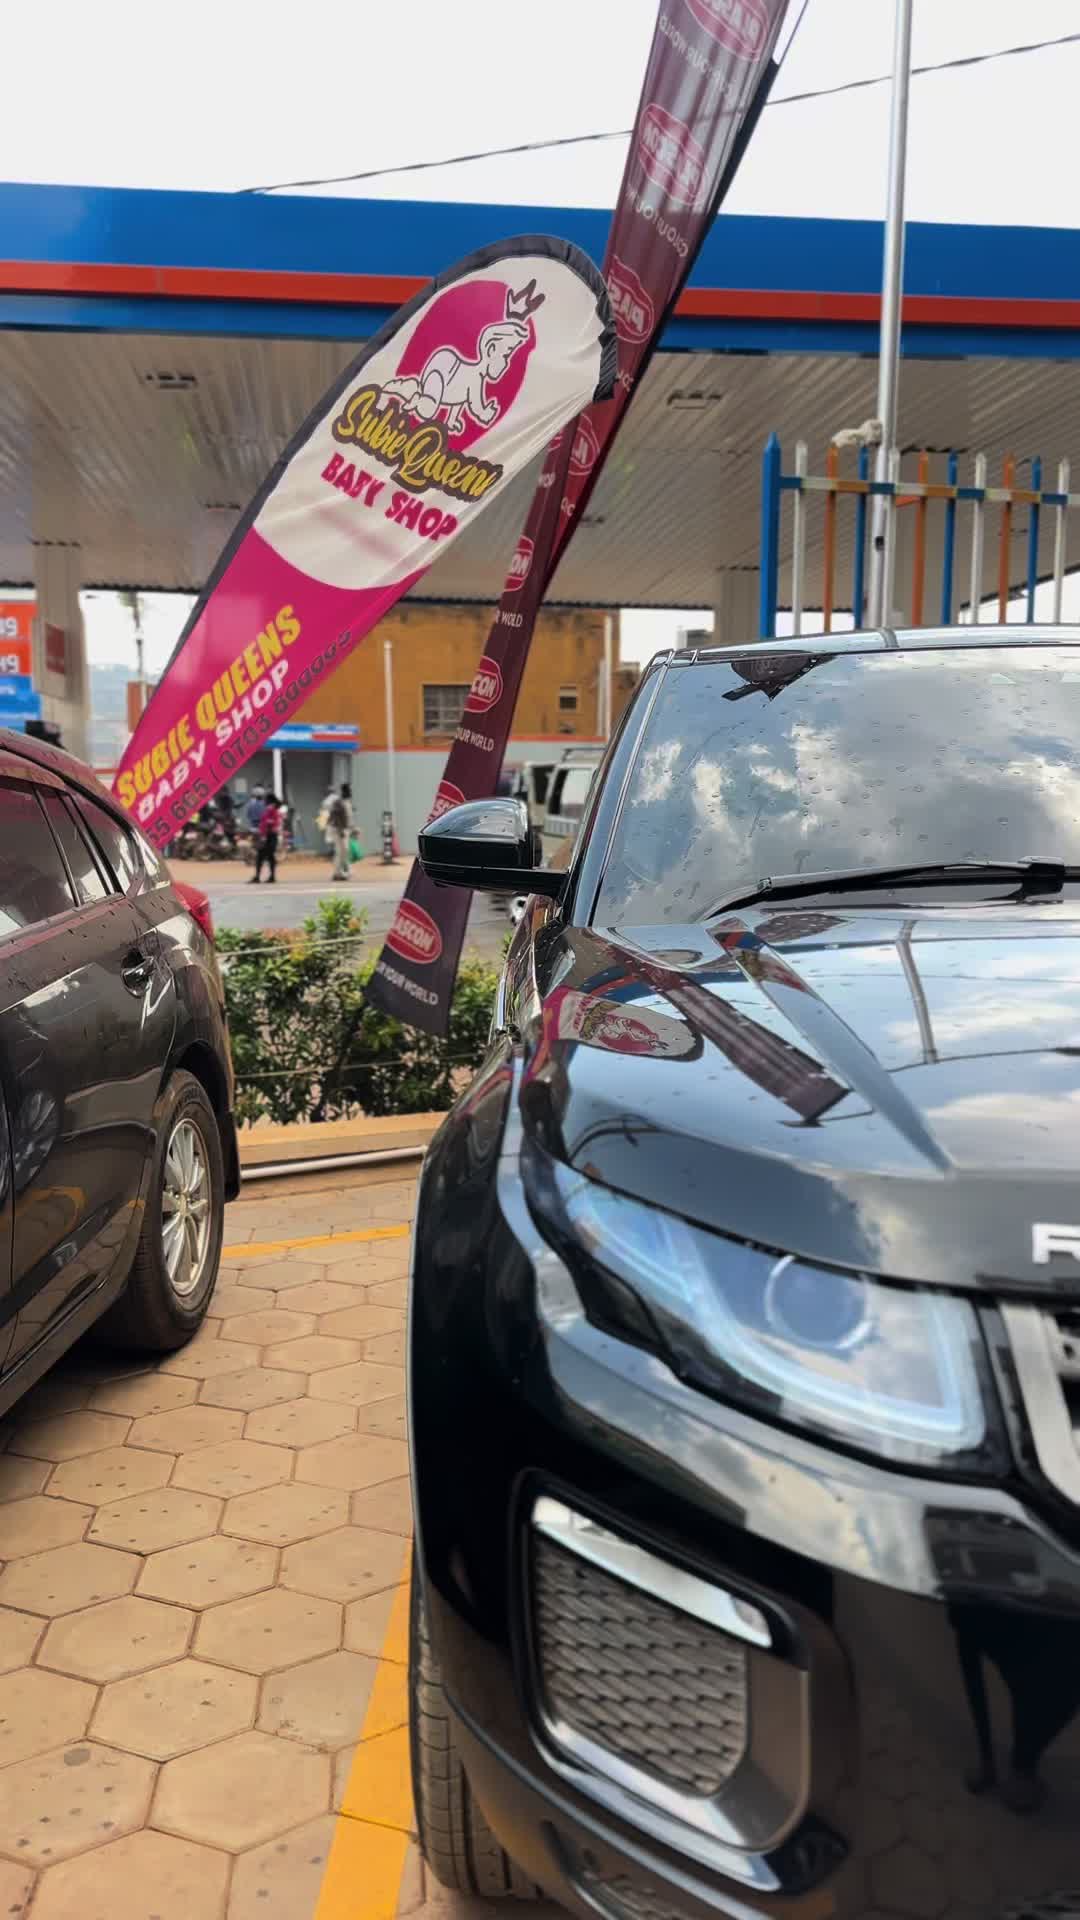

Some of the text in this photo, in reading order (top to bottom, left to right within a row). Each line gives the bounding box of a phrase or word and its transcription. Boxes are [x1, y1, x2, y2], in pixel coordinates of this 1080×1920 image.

[320, 452, 460, 542] BABY SHOP
[116, 713, 196, 810] SUBIE
[195, 604, 302, 732] QUEENS
[137, 658, 289, 822] BABY SHOP
